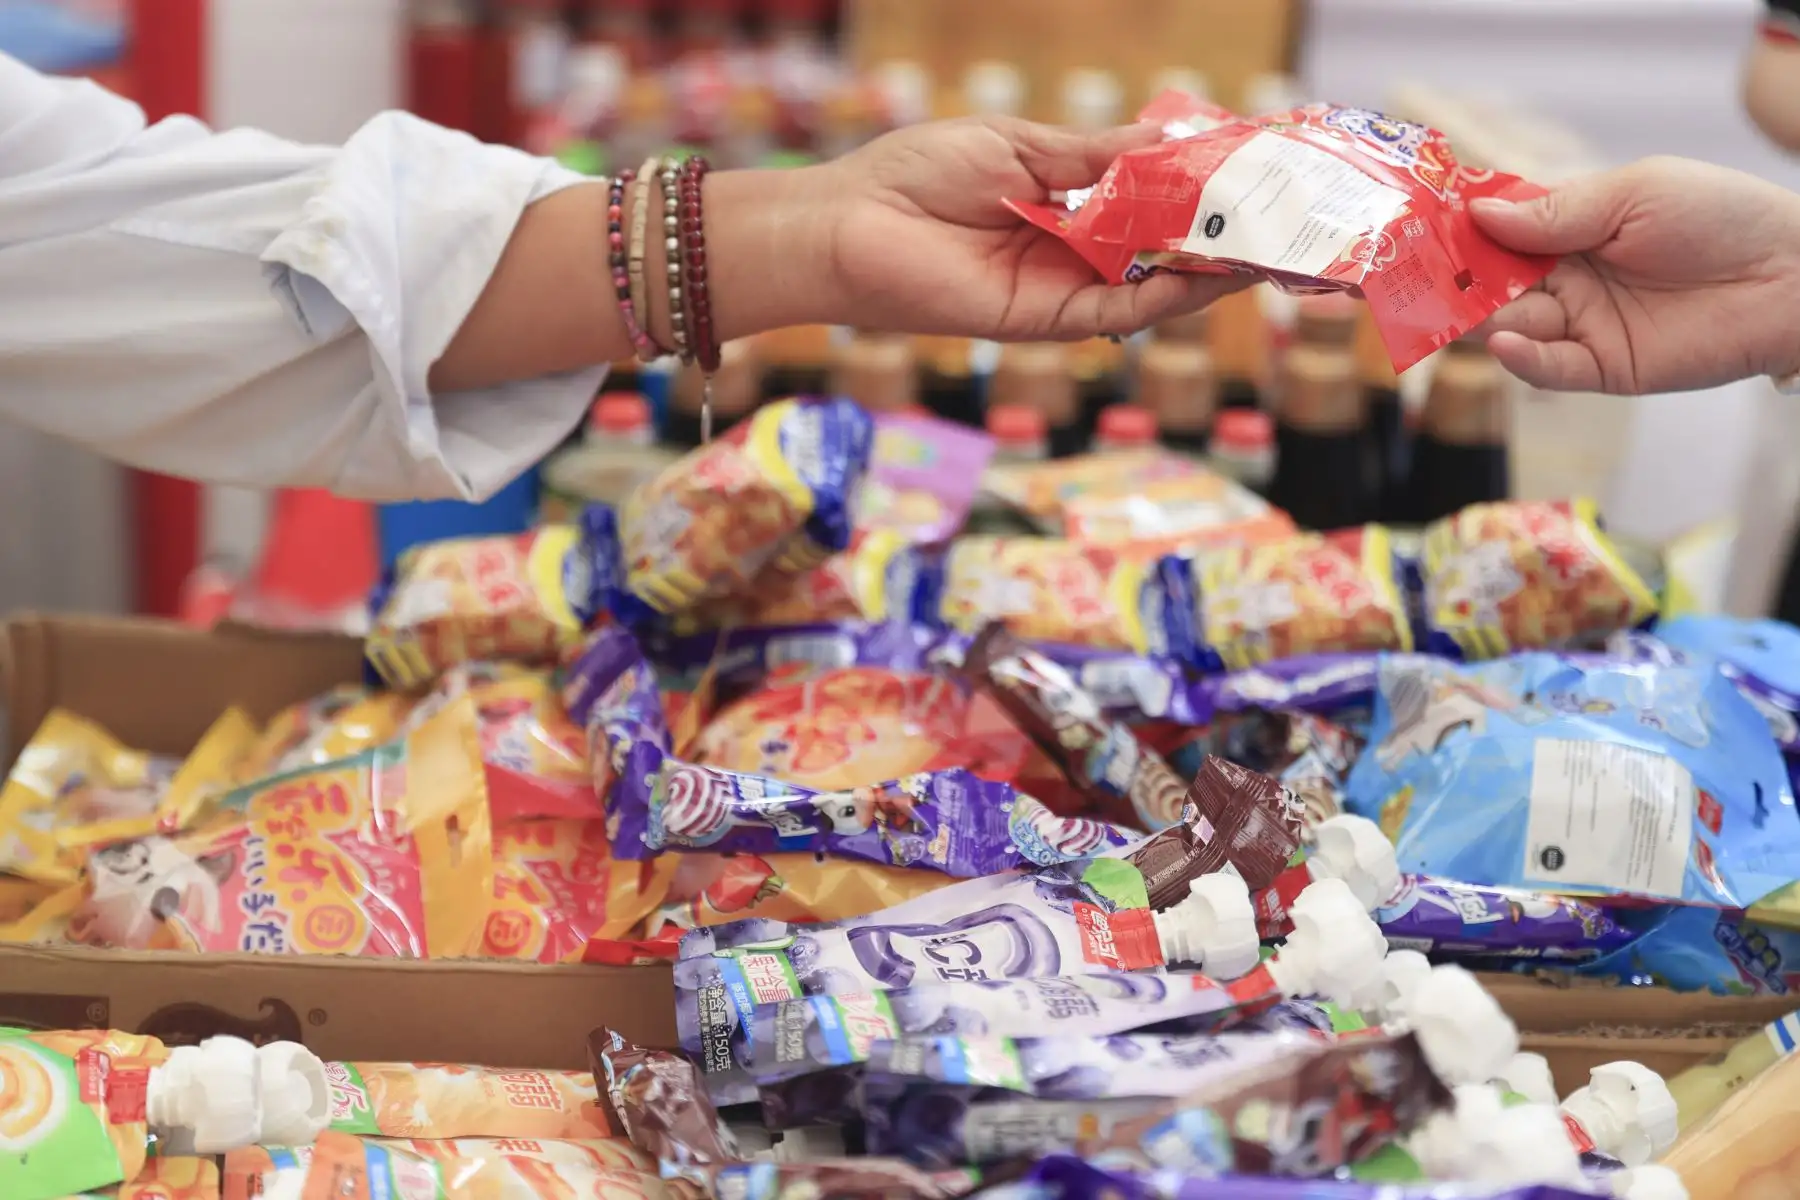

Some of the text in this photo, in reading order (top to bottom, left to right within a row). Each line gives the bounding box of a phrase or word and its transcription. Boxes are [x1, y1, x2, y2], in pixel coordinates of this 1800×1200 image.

[747, 955, 790, 1003] 果汁含量
[706, 985, 732, 1071] 净含量:150克
